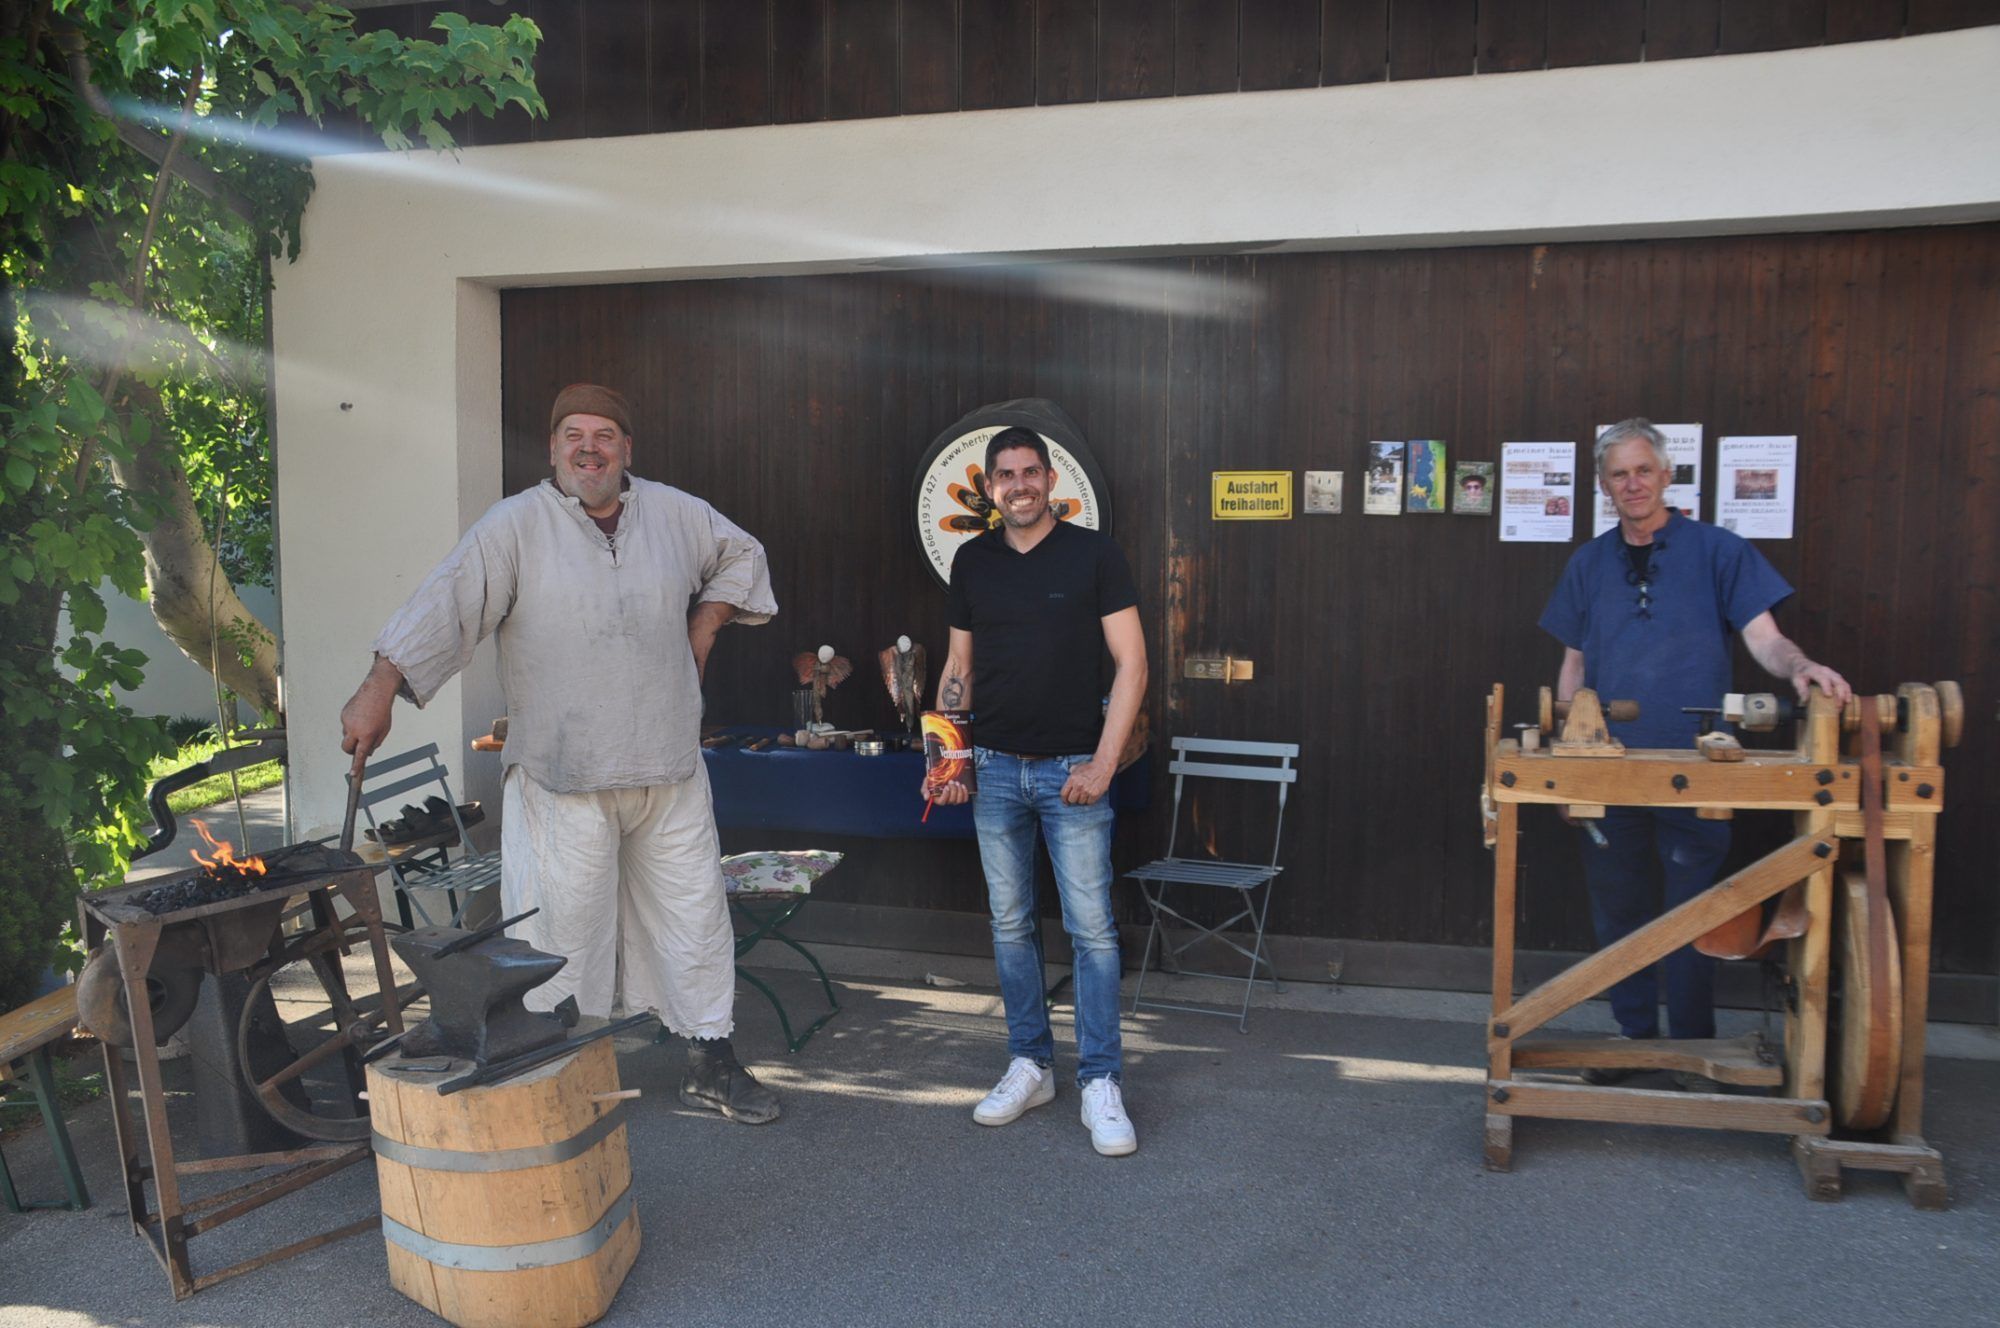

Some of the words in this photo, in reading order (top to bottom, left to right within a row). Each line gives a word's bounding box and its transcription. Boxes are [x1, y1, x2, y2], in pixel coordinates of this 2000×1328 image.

[926, 474, 938, 495] 427
[1227, 481, 1278, 494] Ausfahrt
[922, 496, 931, 510] 57
[1221, 498, 1284, 511] freihalten!
[922, 511, 931, 524] 19
[924, 528, 936, 548] 664
[931, 548, 945, 567] +43
